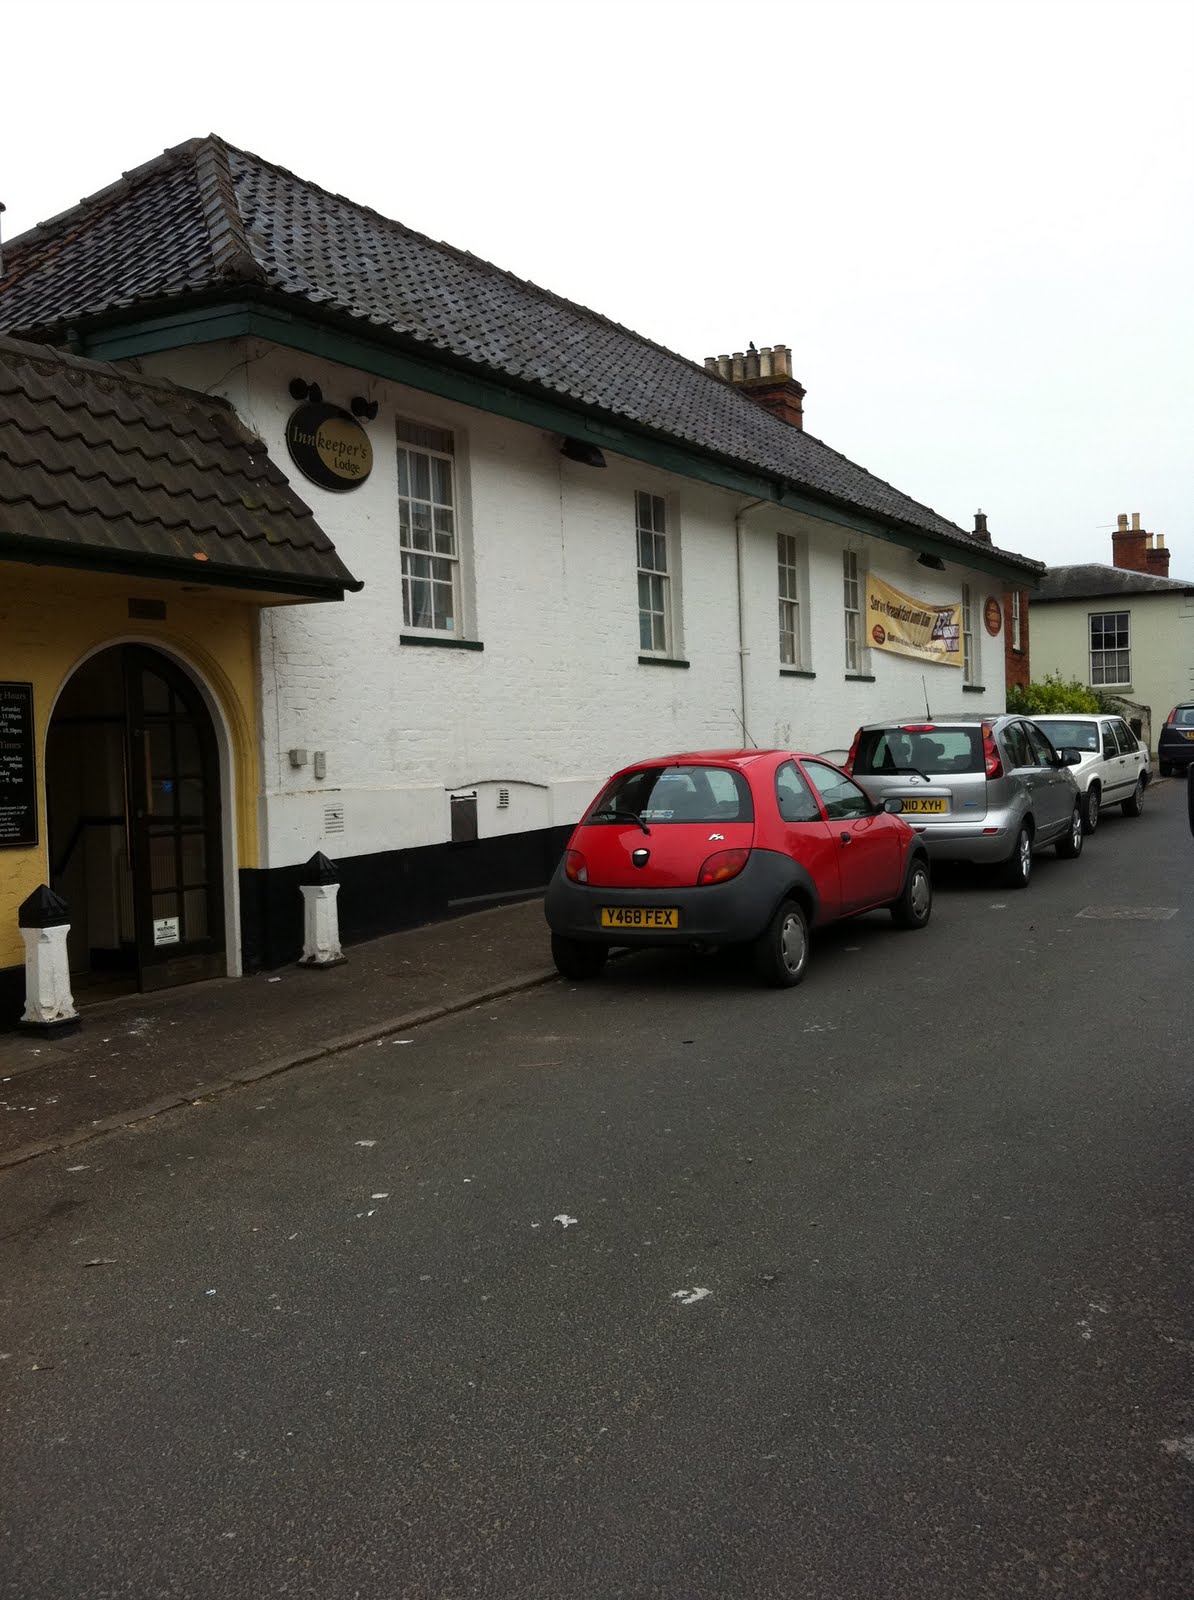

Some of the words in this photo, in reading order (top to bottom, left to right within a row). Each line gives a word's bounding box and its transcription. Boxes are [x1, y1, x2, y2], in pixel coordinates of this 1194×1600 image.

[293, 426, 368, 459] Innkeeper's
[334, 457, 361, 476] Lodge
[4, 691, 26, 700] Hours
[2, 755, 23, 763] Saturday
[920, 800, 942, 810] XYH
[607, 909, 642, 924] Y468
[645, 910, 672, 925] FEX
